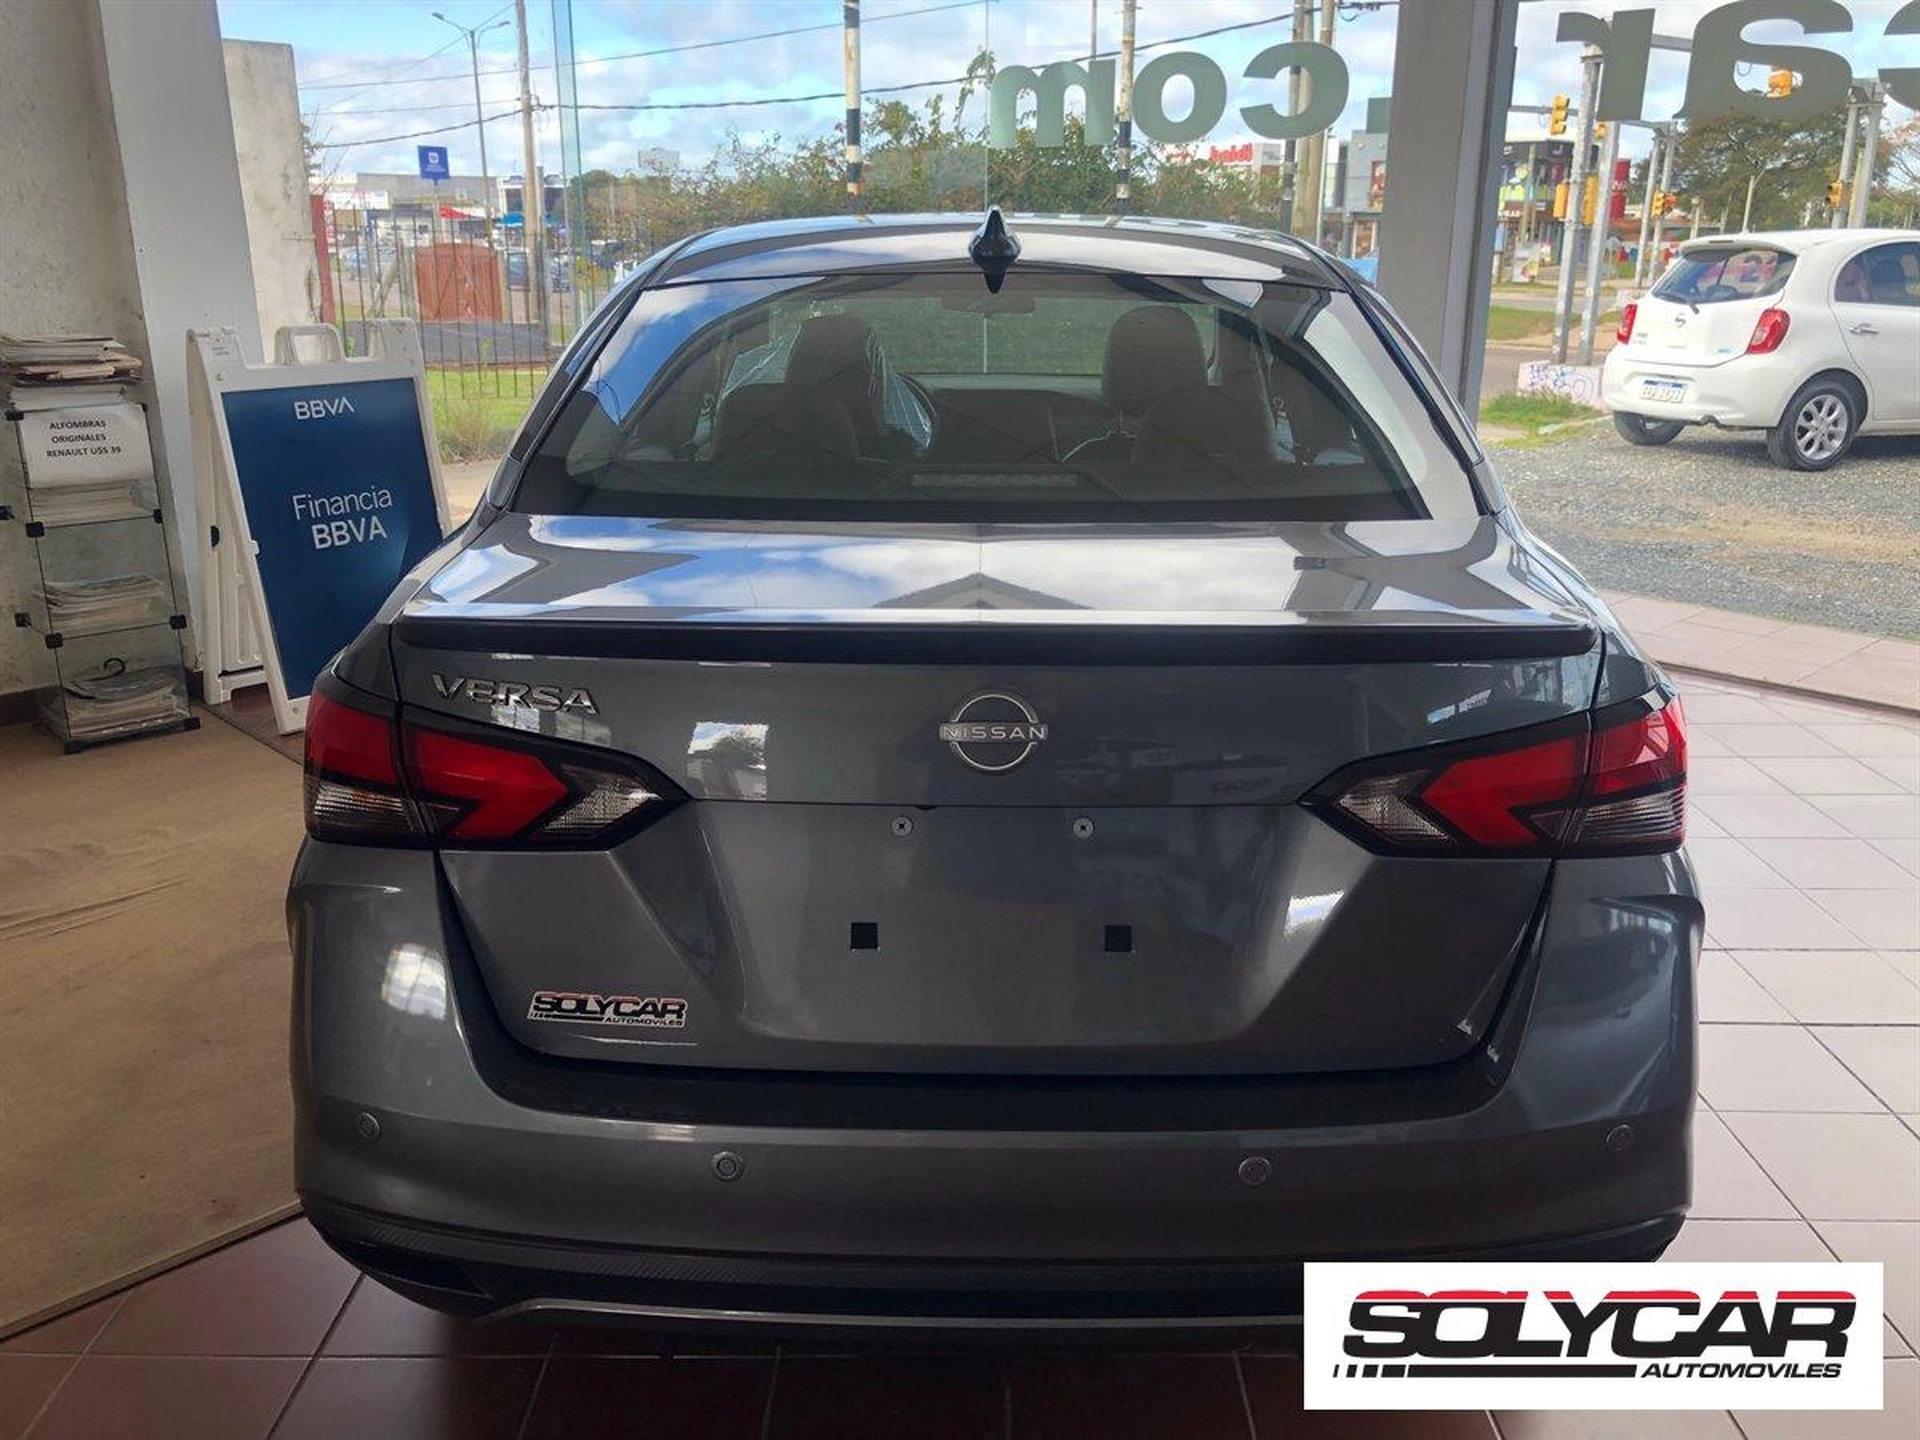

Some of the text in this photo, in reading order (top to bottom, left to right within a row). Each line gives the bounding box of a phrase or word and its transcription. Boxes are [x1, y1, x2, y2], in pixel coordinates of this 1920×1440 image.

[294, 396, 355, 420] BBVA
[49, 420, 107, 430] ALFOMBRAS
[51, 433, 107, 444] ORIGINALES
[46, 447, 88, 457] RENAULT
[110, 445, 121, 454] 39
[292, 485, 392, 520] Financia
[311, 518, 388, 550] BBVA
[432, 672, 600, 715] VERSA
[942, 725, 1046, 740] NISSAN
[532, 992, 687, 1019] SOLYCAR
[603, 1016, 684, 1027] AUTOMOVILES
